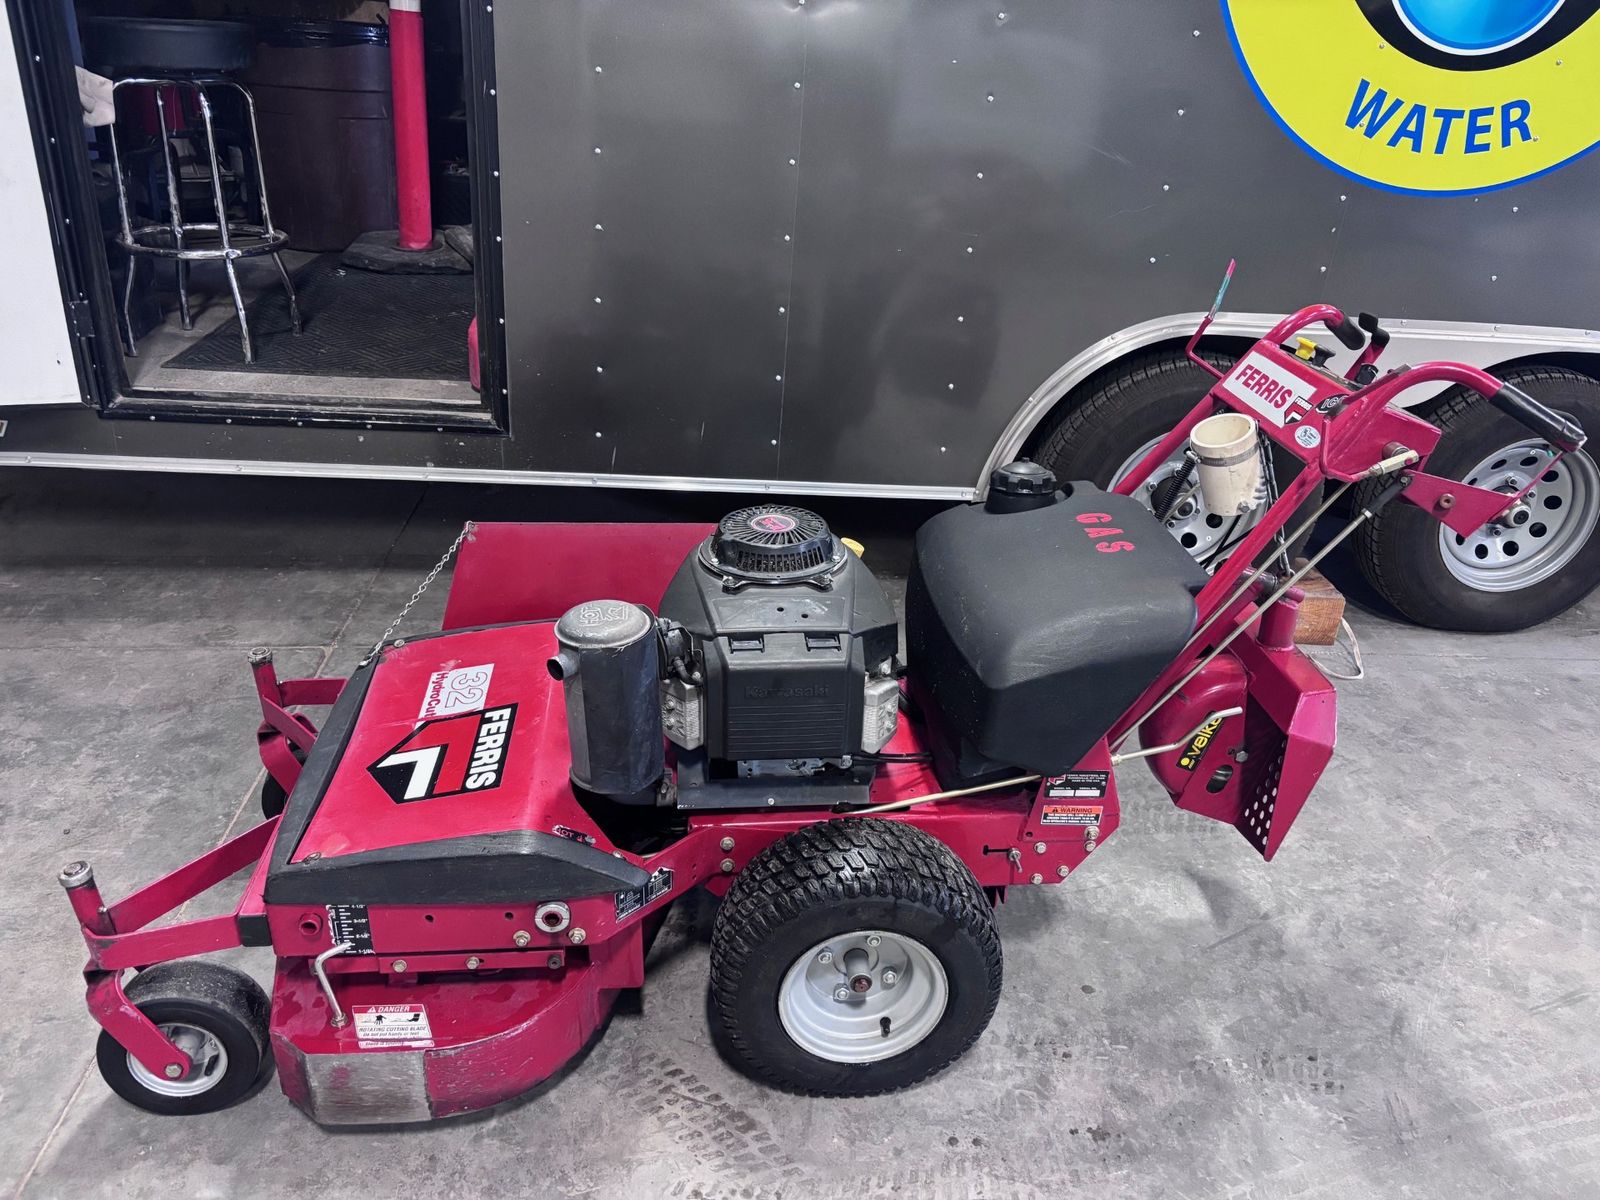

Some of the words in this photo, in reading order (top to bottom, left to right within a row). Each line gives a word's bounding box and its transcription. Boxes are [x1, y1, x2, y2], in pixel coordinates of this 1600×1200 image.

[1345, 78, 1532, 155] WATER
[1235, 363, 1293, 409] FERRIS
[1075, 512, 1136, 553] GAS
[425, 672, 450, 718] HydroCut
[445, 671, 488, 708] 32
[465, 708, 512, 789] FERRIS
